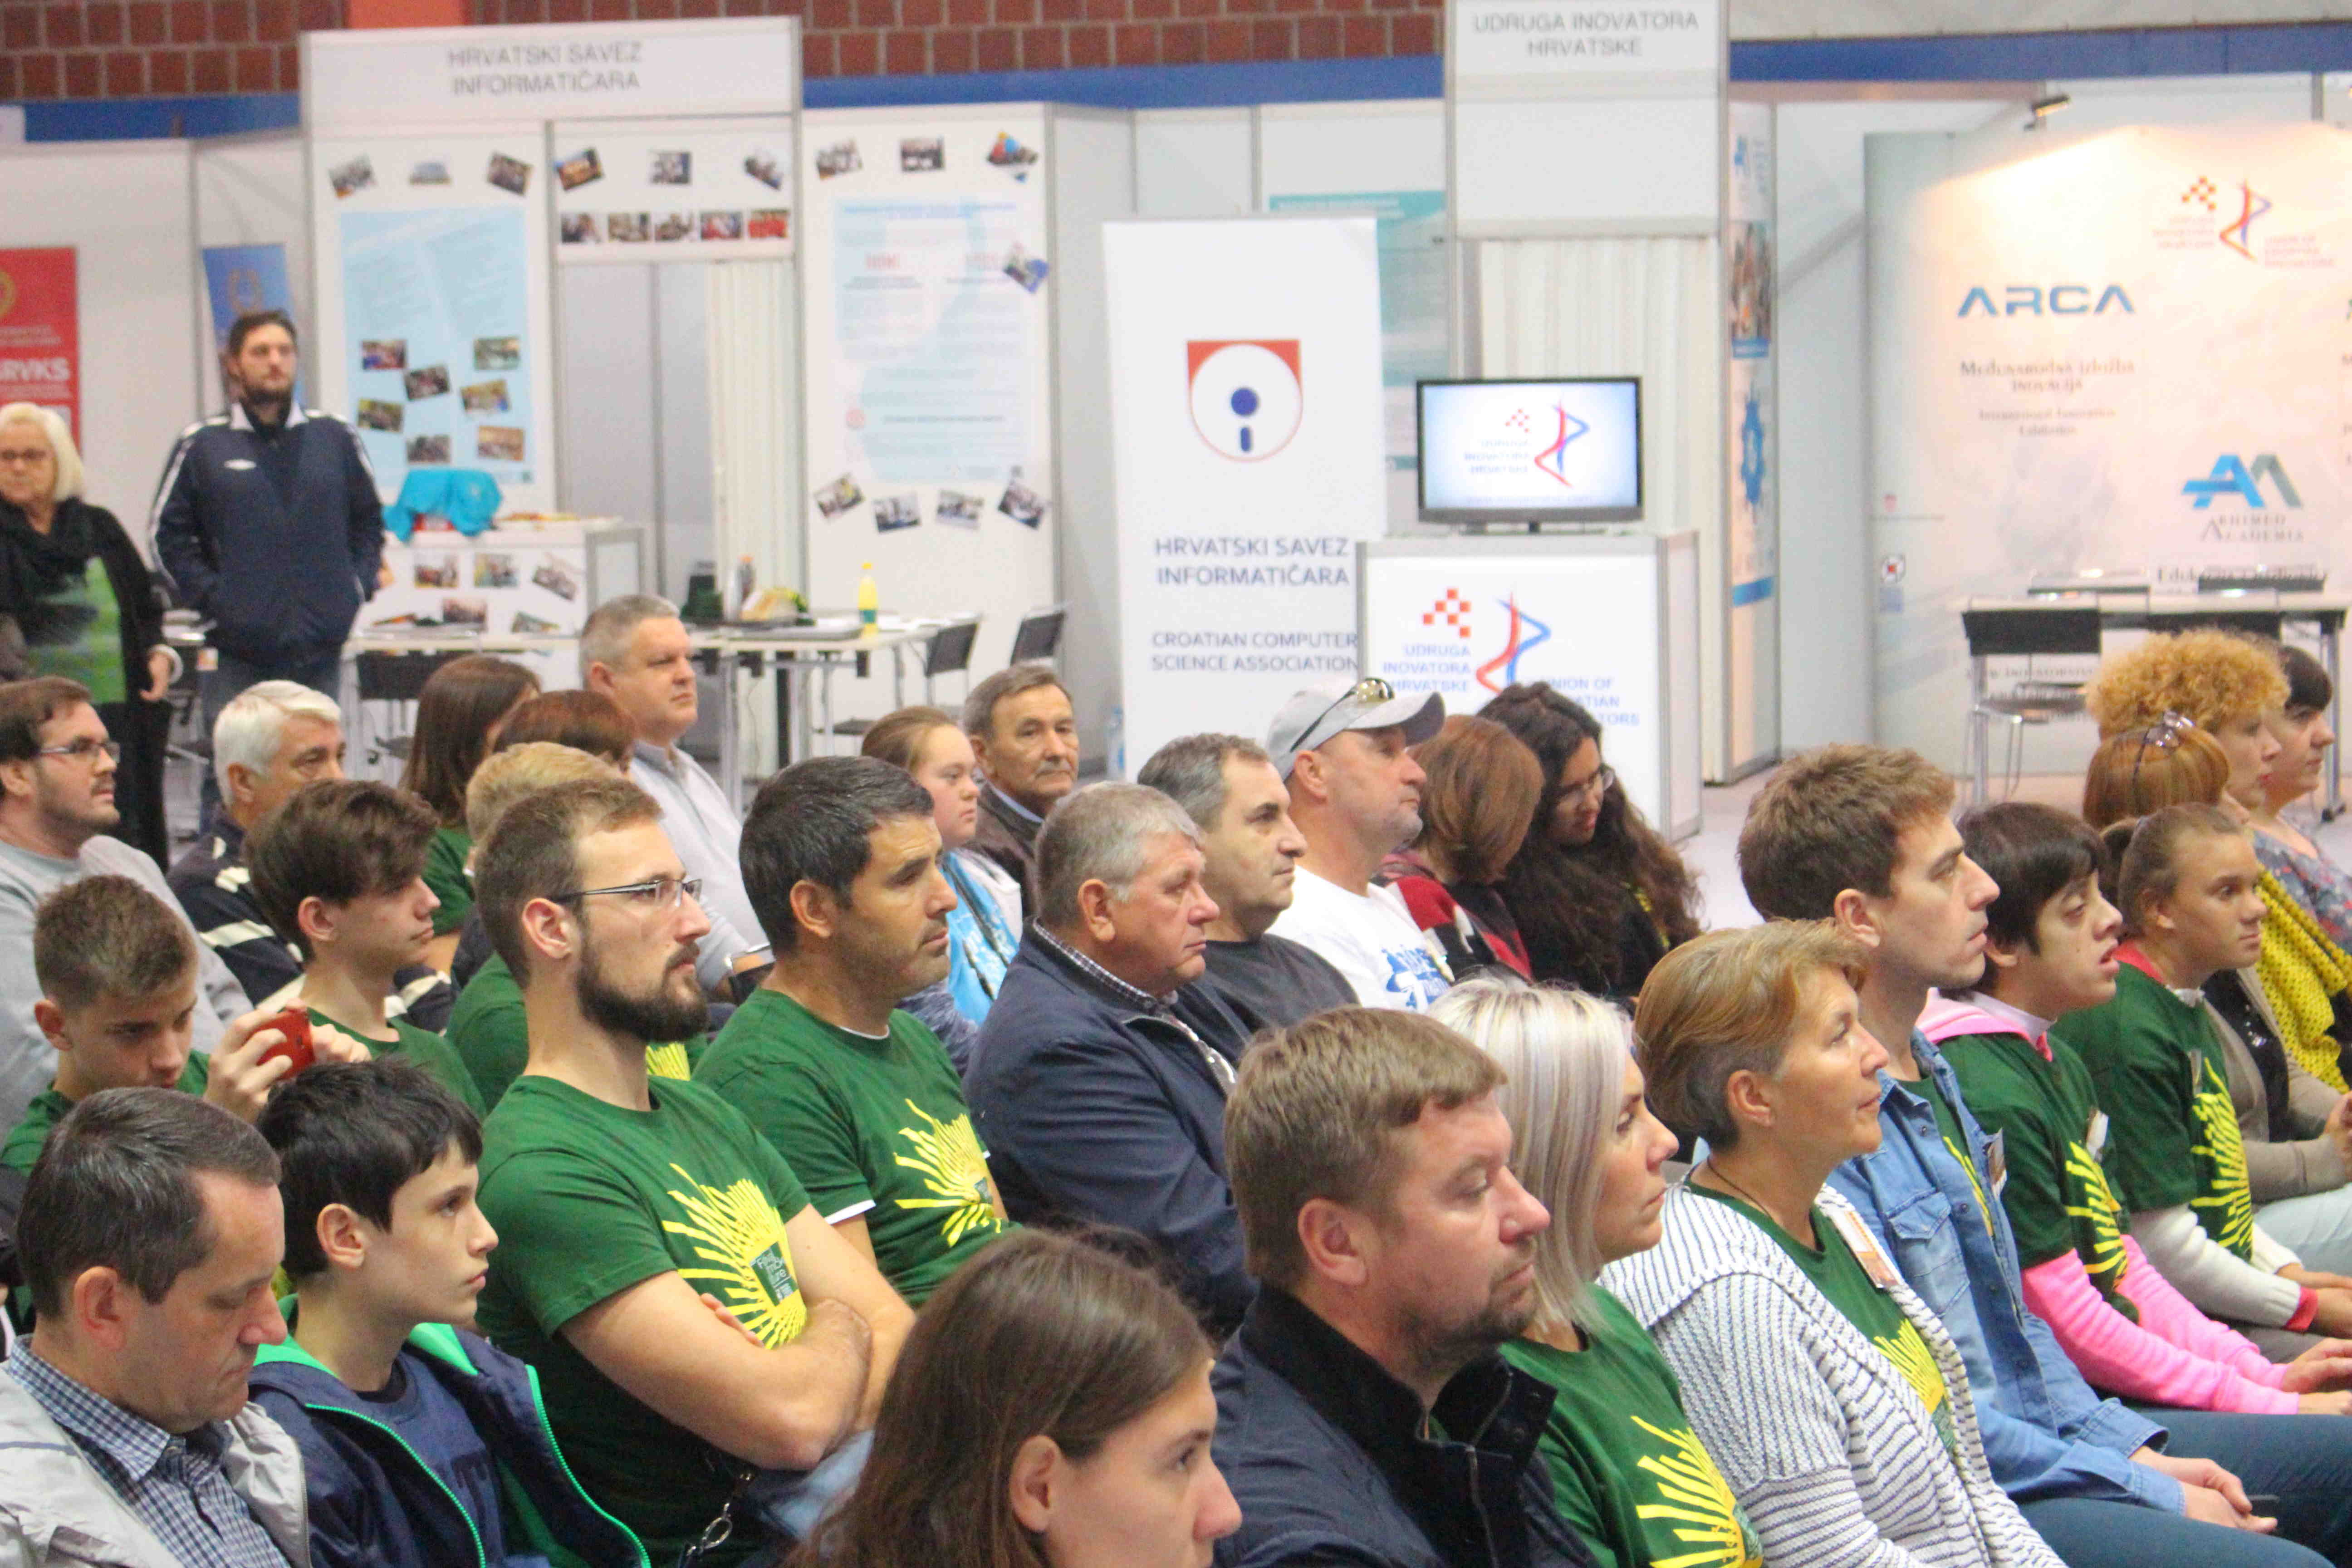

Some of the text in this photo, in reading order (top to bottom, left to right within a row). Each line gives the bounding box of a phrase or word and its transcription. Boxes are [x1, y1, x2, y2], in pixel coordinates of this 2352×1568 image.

[1474, 10, 1699, 33] UDRUGA INOVATORA
[446, 42, 642, 67] HRVATSKI SAVEZ
[1528, 37, 1642, 57] HRVATSKE
[454, 69, 640, 95] INFORMATIČARA
[1957, 284, 2135, 317] ARCA
[1155, 537, 1350, 557] HRVATSKI SAVEZ
[1158, 564, 1350, 586] INFORMATIČARA
[1152, 631, 1358, 649] CROATIAN COMPUTER
[1404, 644, 1471, 657] UDRUGA
[1152, 655, 1358, 672] SCIENCE ASSOCIATION
[1383, 662, 1471, 674] INOVATORA
[1390, 679, 1468, 692] HRVATSKE
[1542, 678, 1612, 690] NION OF
